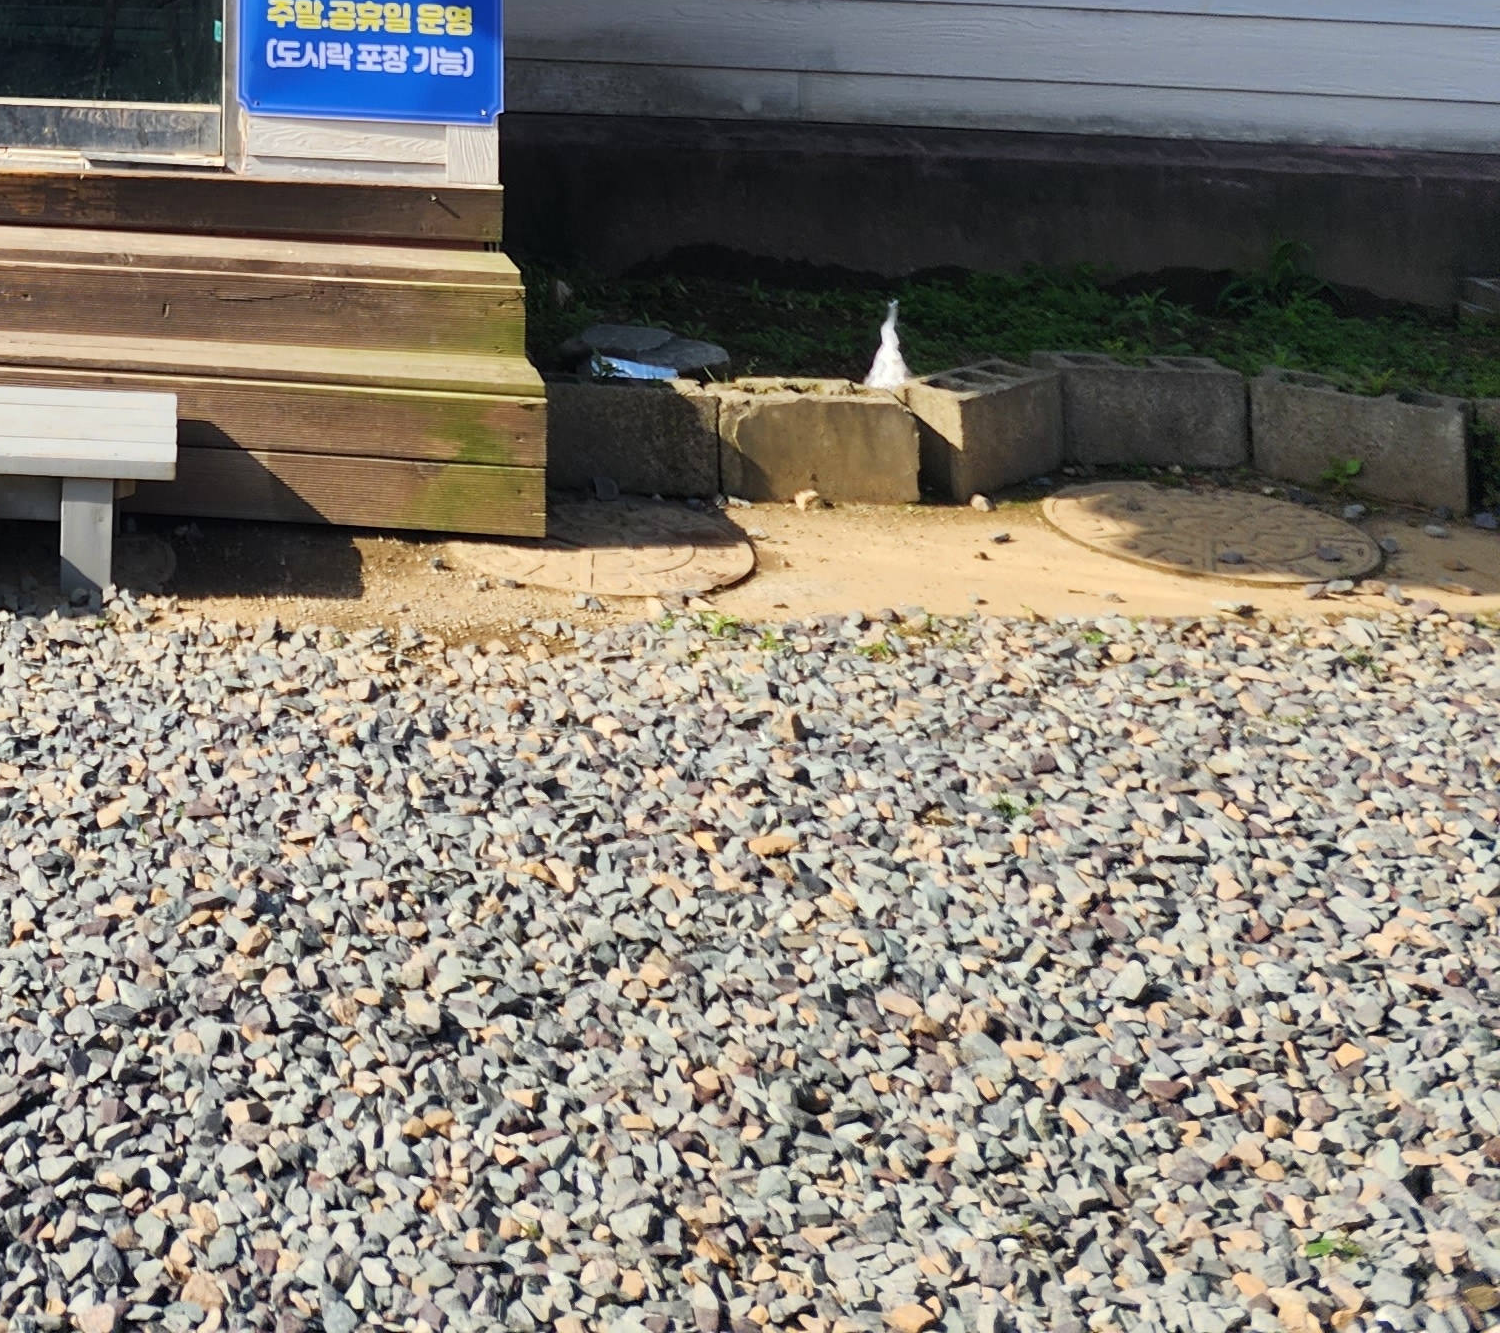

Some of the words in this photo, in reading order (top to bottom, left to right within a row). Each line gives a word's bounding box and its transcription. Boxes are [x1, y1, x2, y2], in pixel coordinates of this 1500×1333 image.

[417, 3, 474, 36] 운영
[266, 38, 353, 71] (도시락
[356, 43, 410, 74] 포장
[412, 46, 475, 78] 가능)
